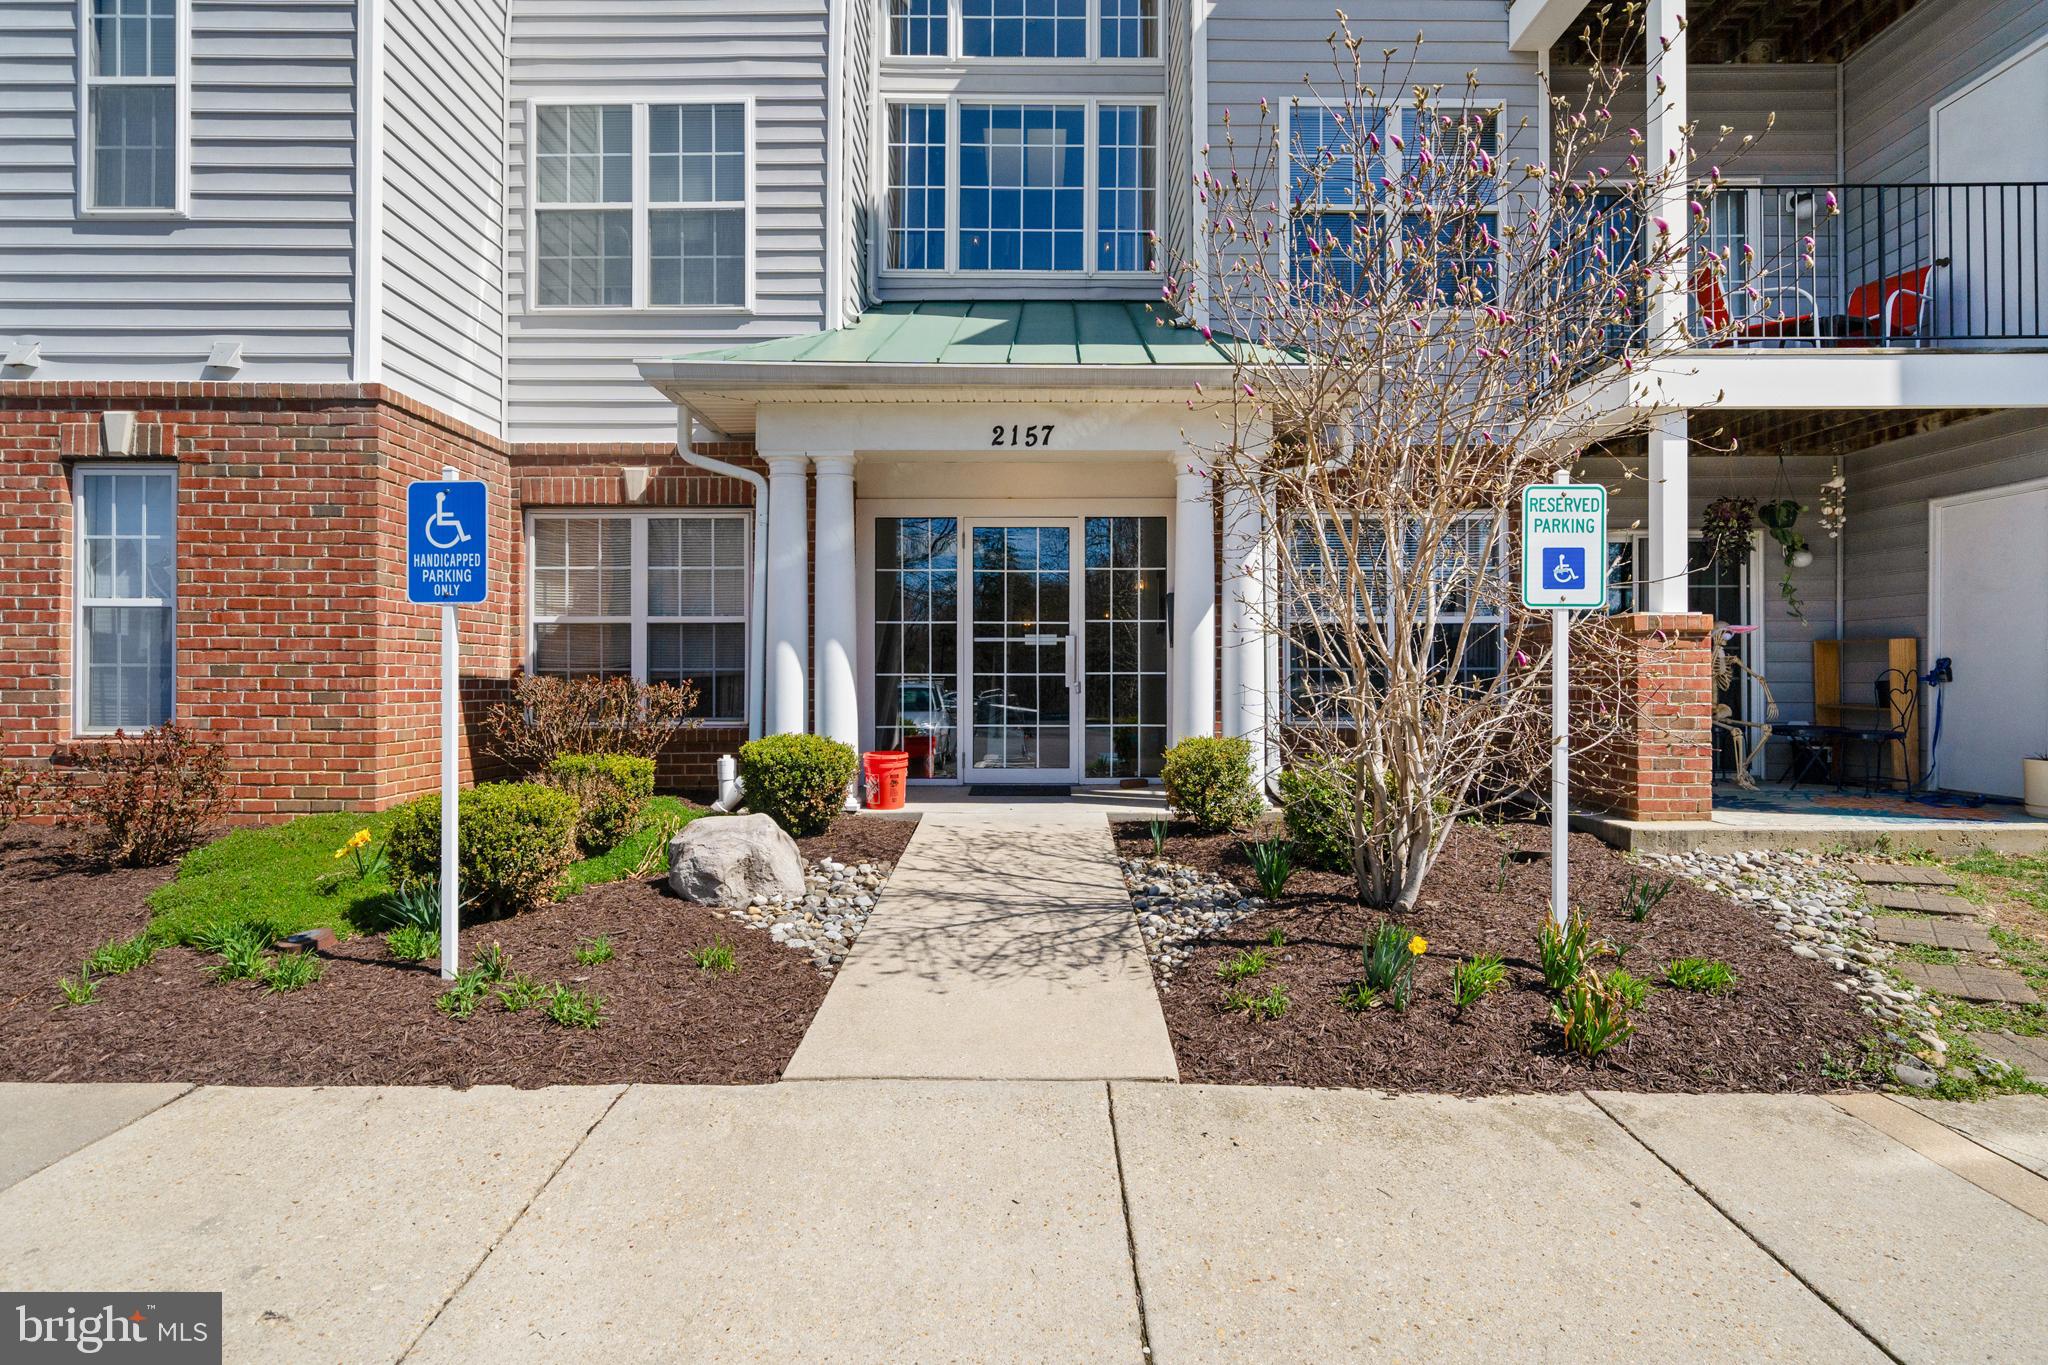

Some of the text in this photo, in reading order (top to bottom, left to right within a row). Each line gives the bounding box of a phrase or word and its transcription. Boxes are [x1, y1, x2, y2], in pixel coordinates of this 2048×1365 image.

[991, 424, 1055, 447] 2157
[1529, 497, 1600, 513] RESERVED
[1534, 518, 1595, 533] PARKING
[413, 553, 480, 567] HANDICAPPED
[422, 569, 472, 582] PARKING
[434, 584, 460, 596] ONLY
